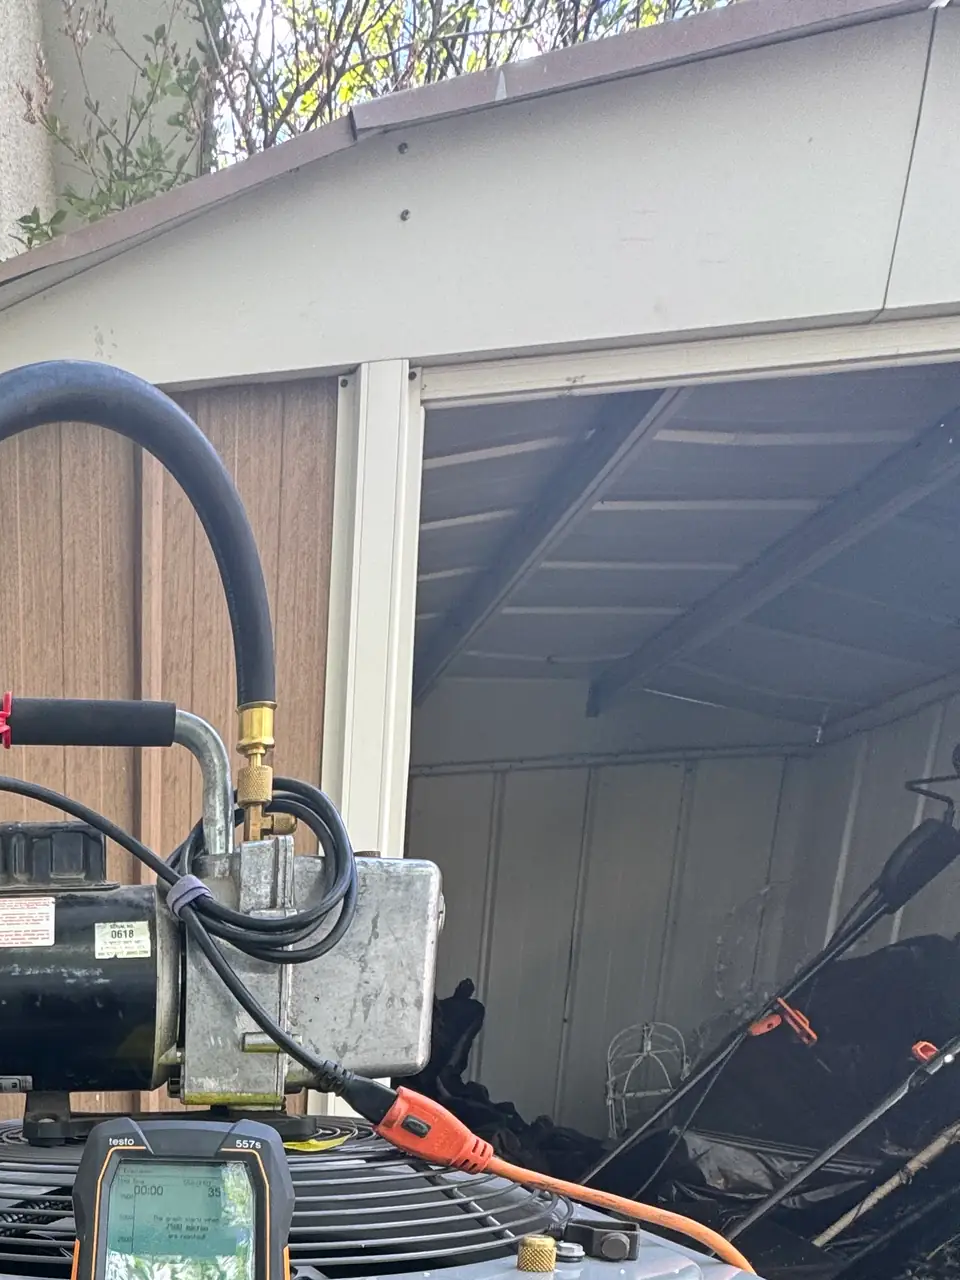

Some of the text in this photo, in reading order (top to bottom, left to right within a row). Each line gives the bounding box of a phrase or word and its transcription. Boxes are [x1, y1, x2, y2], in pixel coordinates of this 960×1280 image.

[110, 929, 135, 939] 0618
[108, 1137, 135, 1146] testo
[235, 1139, 262, 1149] 557s
[134, 1185, 164, 1196] 00:00
